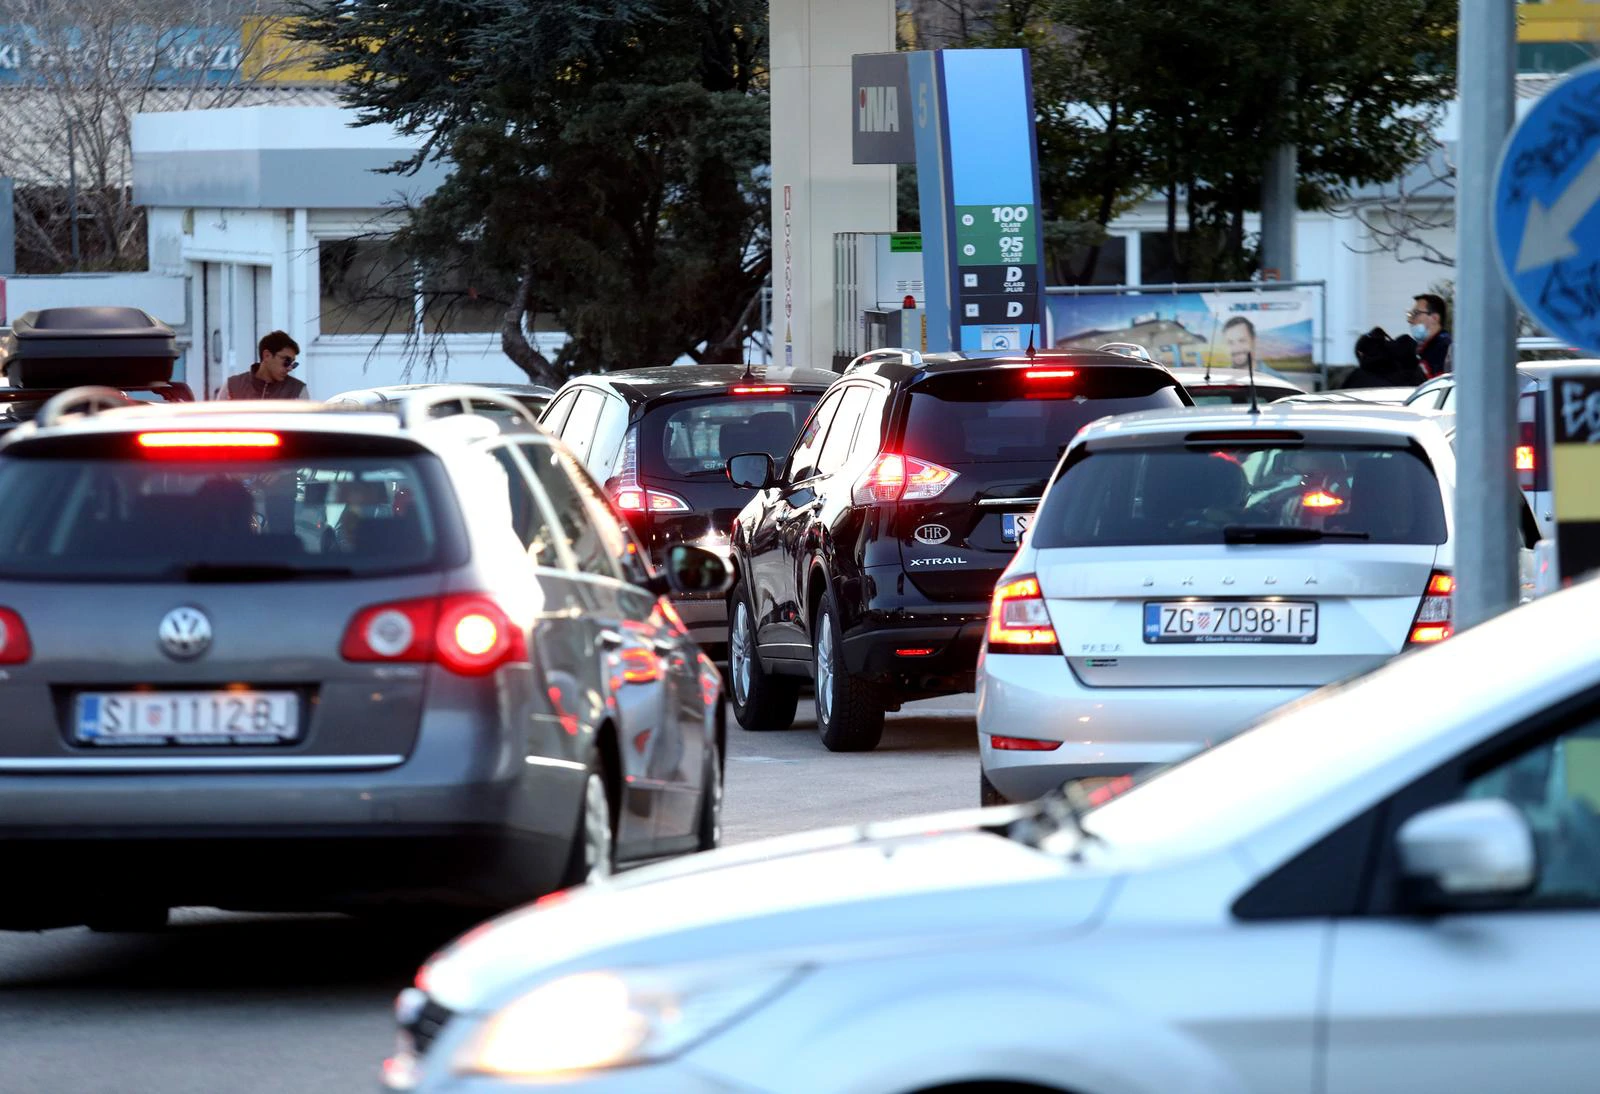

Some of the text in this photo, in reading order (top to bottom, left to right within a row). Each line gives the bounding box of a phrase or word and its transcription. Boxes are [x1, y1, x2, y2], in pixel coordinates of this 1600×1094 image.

[991, 206, 1029, 223] 100
[998, 236, 1024, 252] 95
[1006, 266, 1023, 282] D
[1007, 301, 1024, 318] D
[923, 526, 943, 540] HR
[910, 557, 968, 567] X-TRAIL
[1163, 608, 1195, 633] ZG
